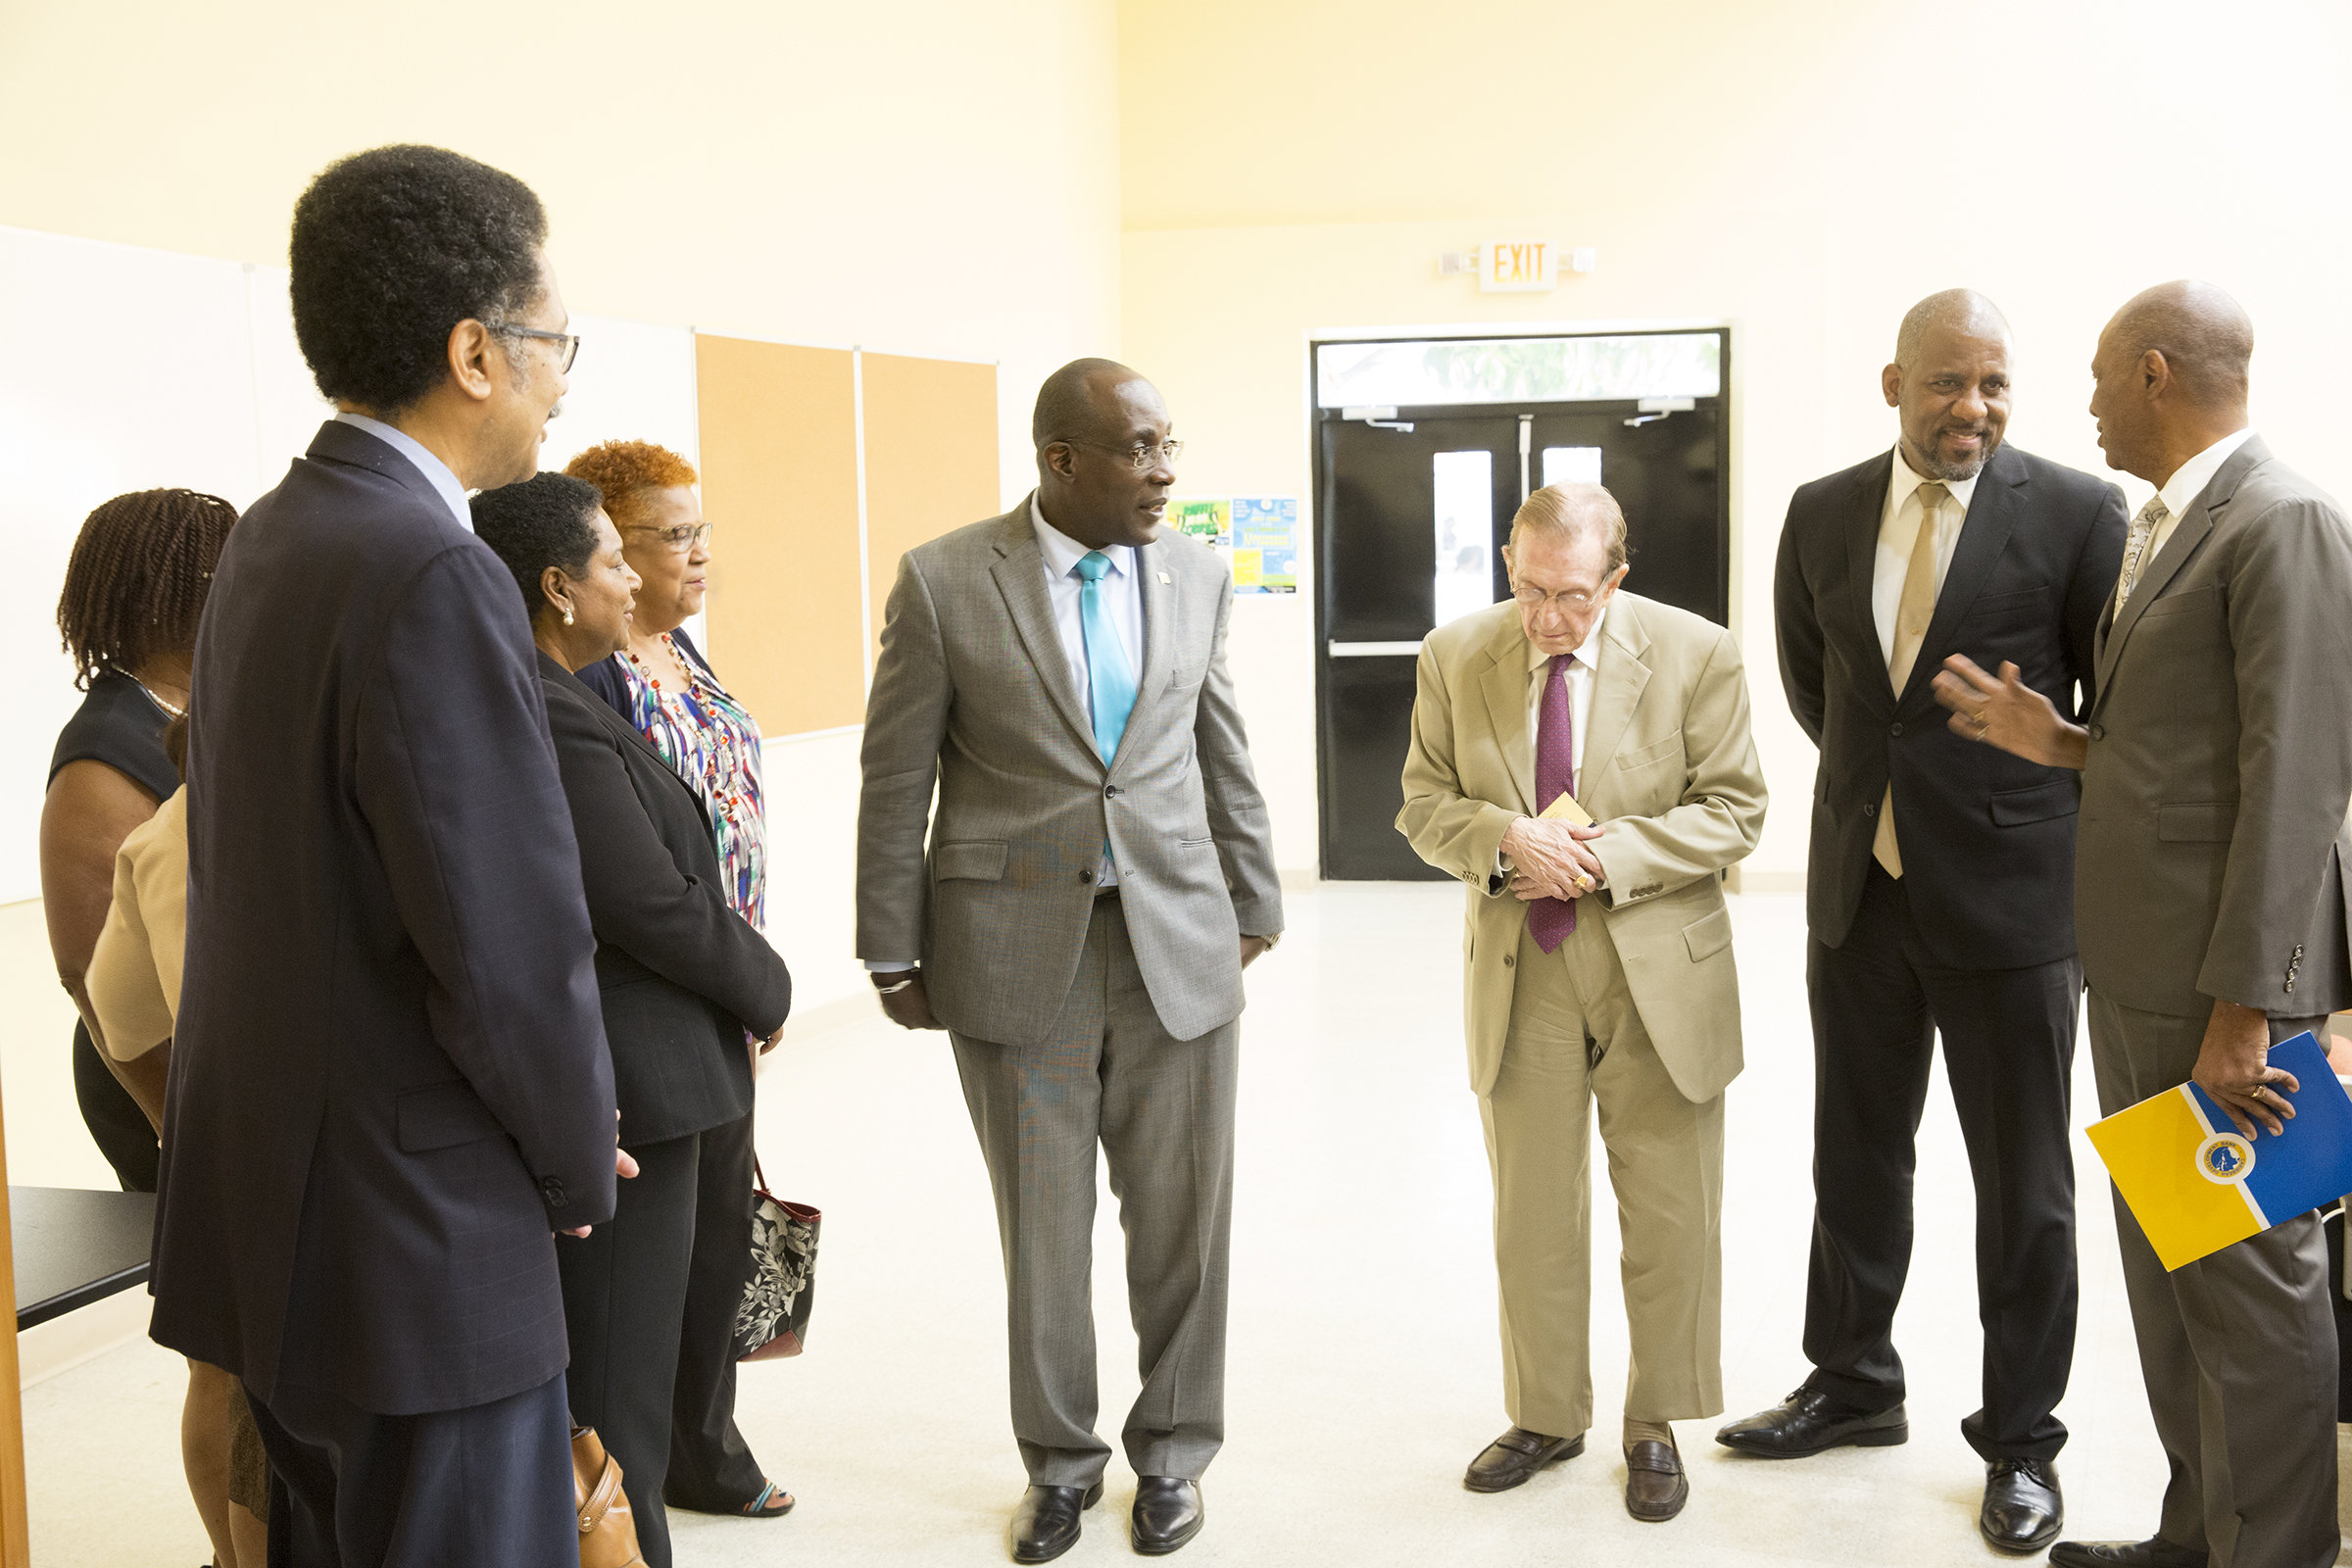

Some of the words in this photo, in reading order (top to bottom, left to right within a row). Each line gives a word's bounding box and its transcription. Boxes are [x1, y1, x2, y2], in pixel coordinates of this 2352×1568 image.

[1494, 244, 1545, 282] EXIT
[2205, 1143, 2219, 1175] DEVELOPMENT
[2221, 1158, 2245, 1176] CARIBBEAN
